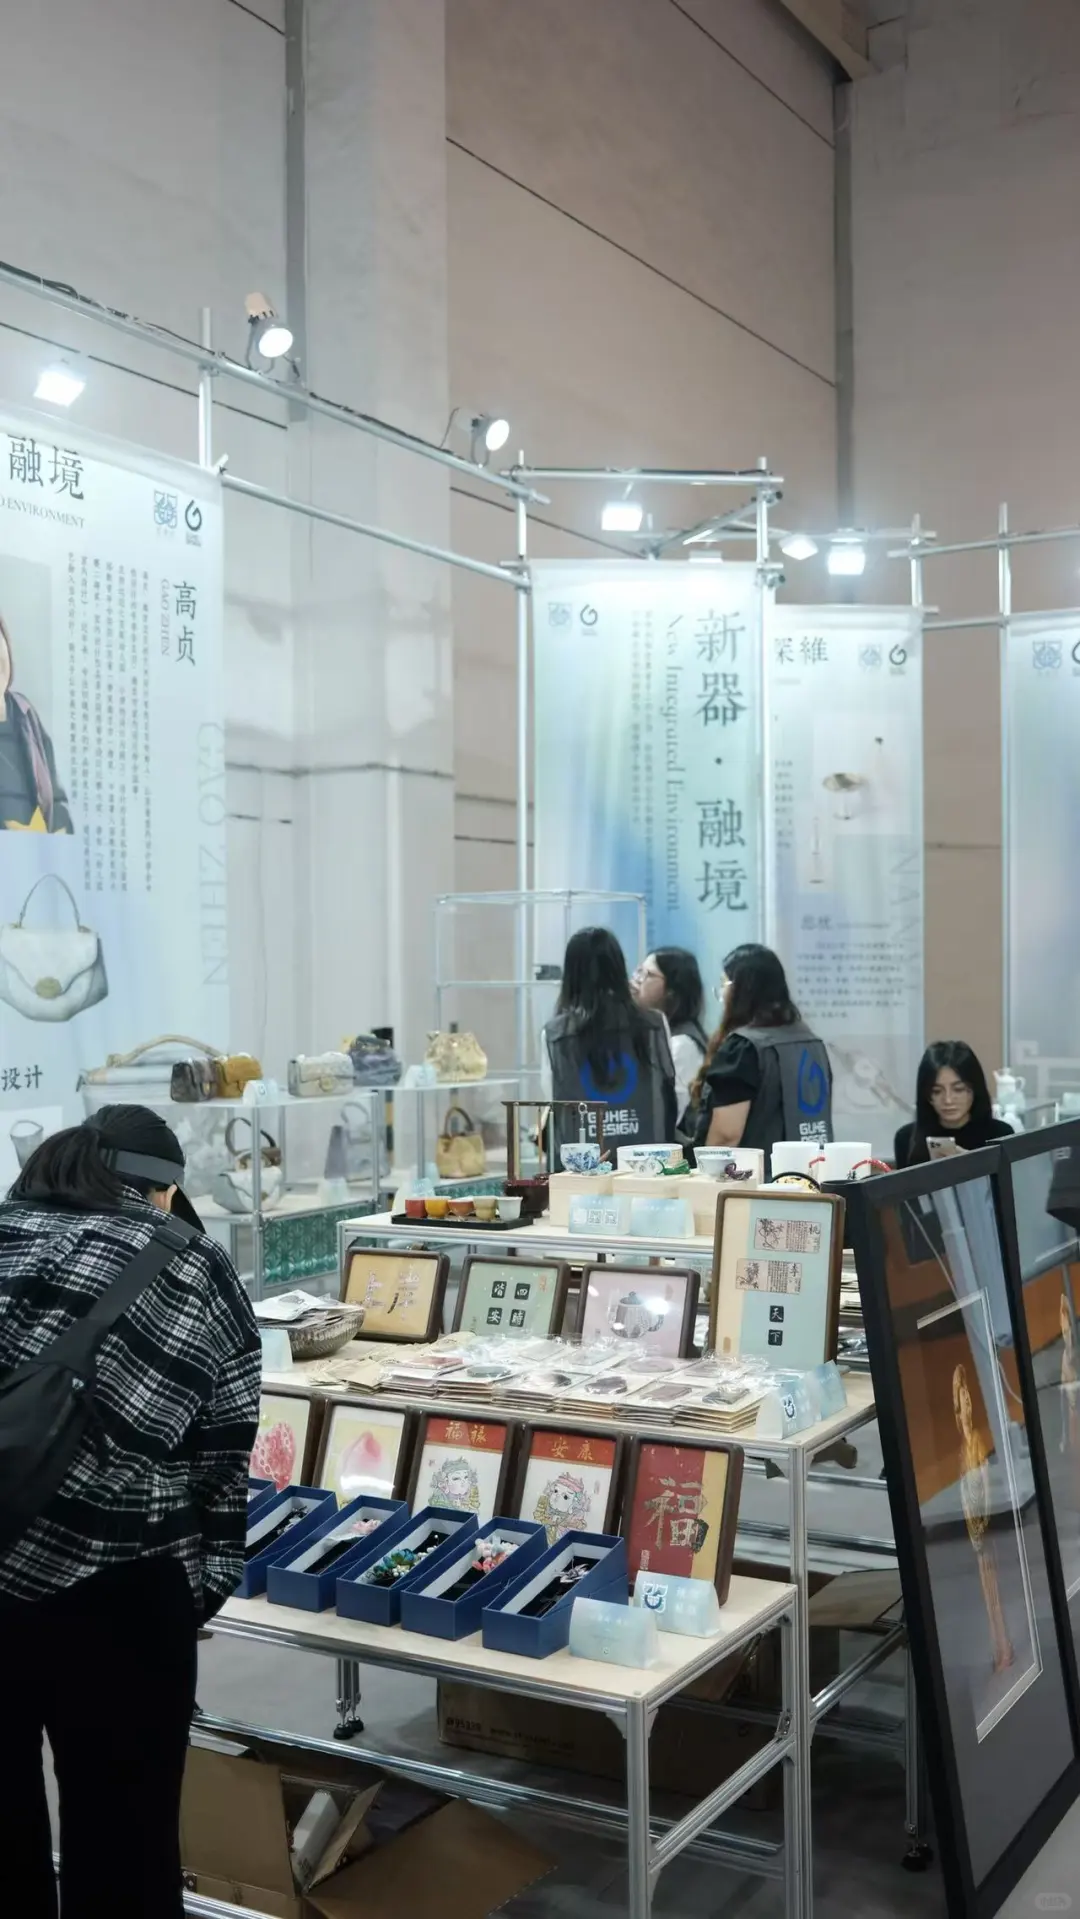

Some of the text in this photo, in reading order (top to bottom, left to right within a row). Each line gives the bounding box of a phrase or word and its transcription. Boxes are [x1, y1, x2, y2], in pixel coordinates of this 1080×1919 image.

[8, 433, 85, 500] 融境
[8, 497, 86, 529] ENVIRONMENT
[173, 580, 197, 667] 高贞
[661, 666, 686, 772] Integrated
[665, 779, 685, 912] Environment
[1, 1065, 44, 1091] 设计
[551, 1437, 595, 1461] 安康
